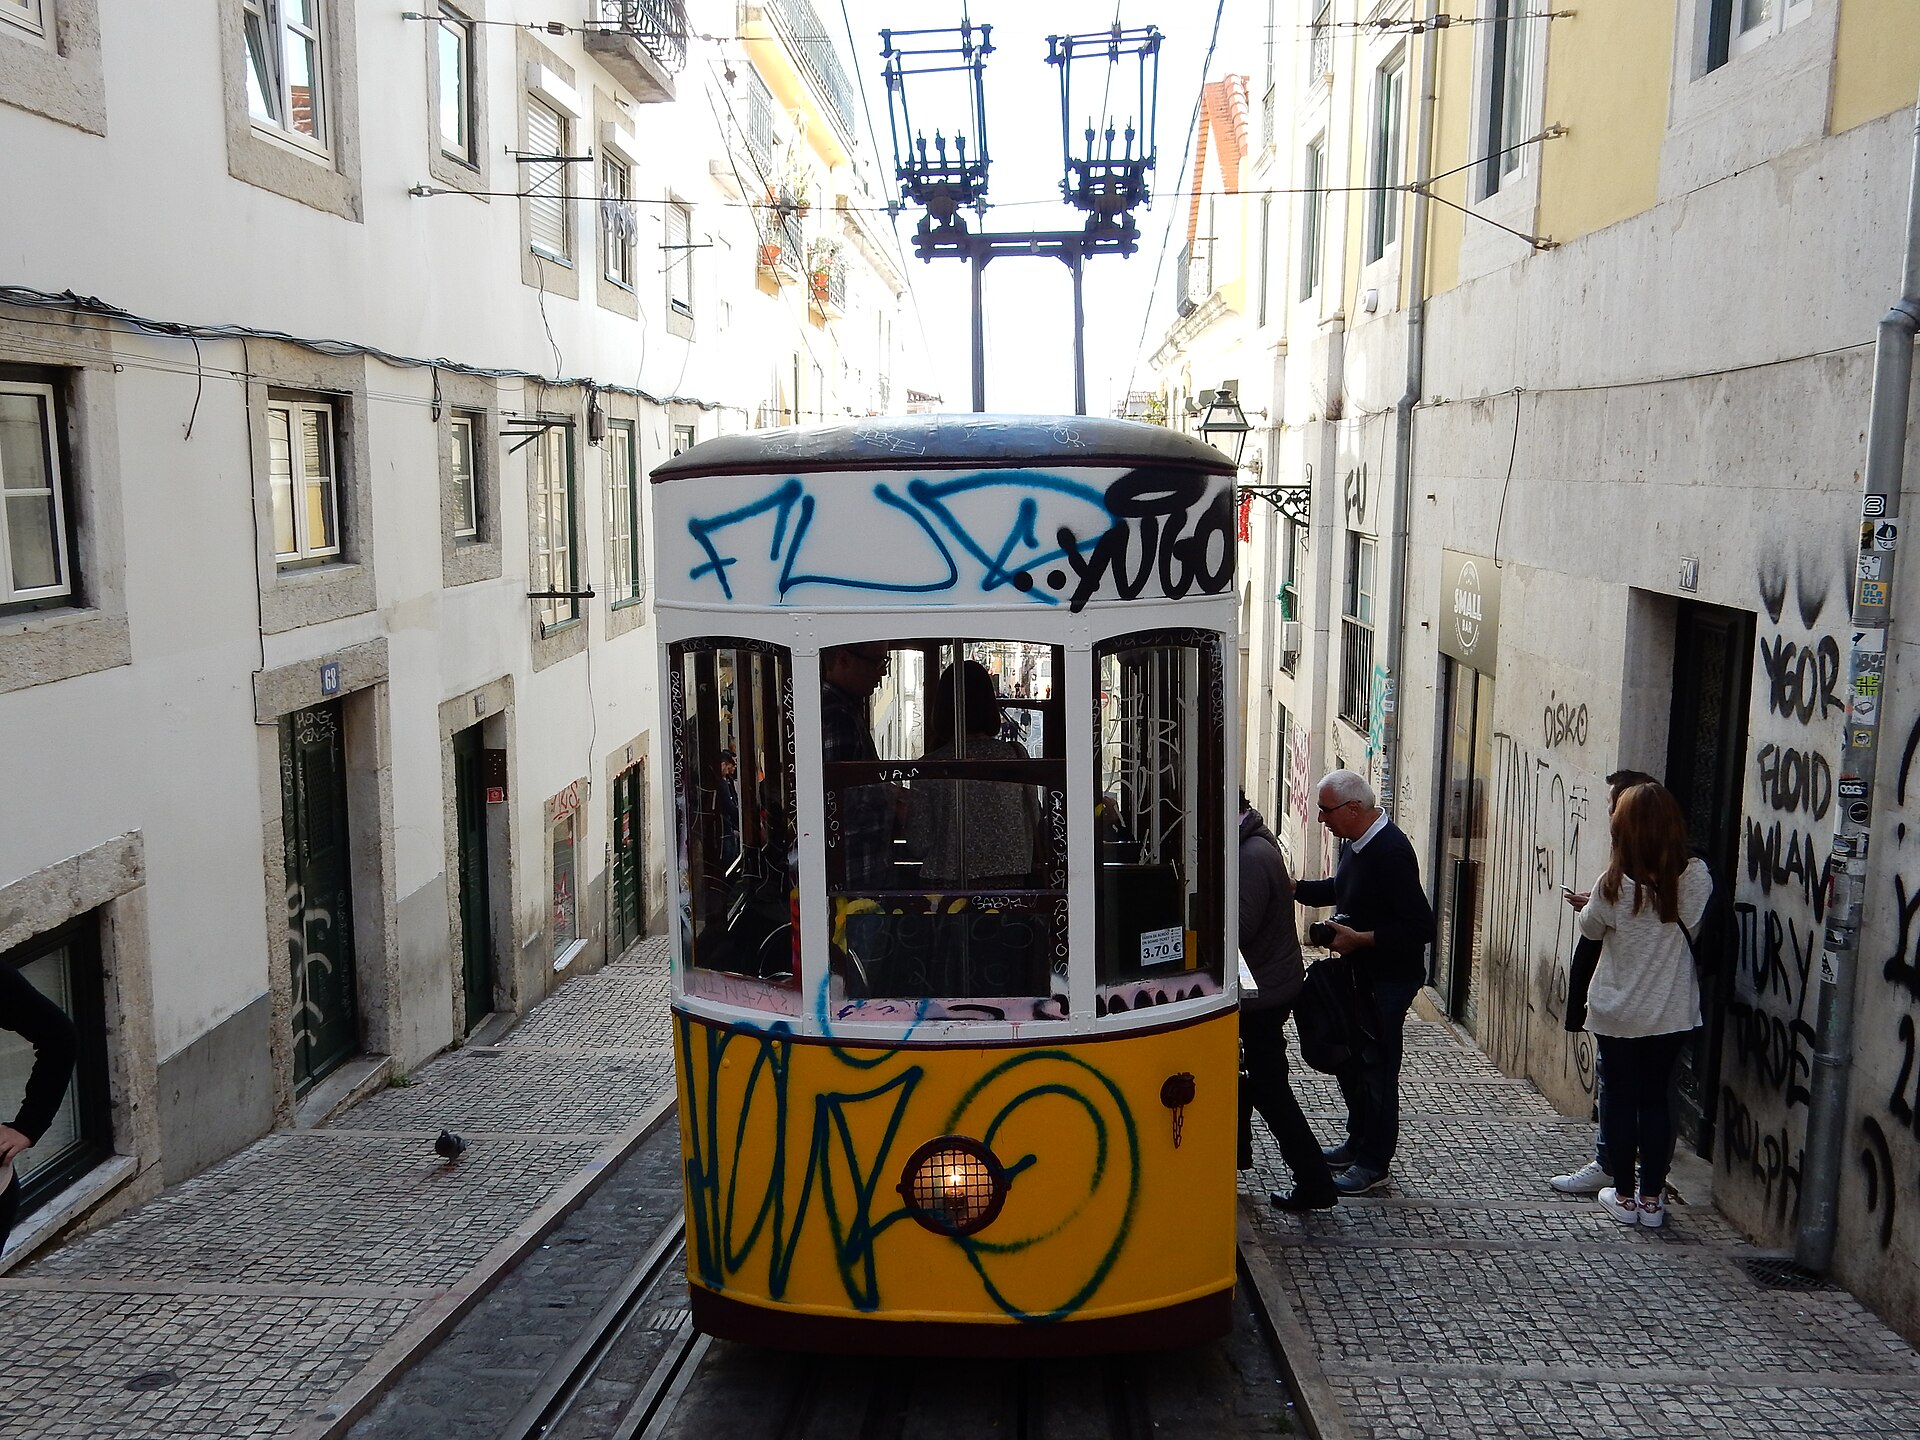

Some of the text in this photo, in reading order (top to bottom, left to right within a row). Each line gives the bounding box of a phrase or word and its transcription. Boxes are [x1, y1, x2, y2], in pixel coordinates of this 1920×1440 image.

[1682, 560, 1694, 587] 79
[1454, 588, 1482, 621] SMALL
[1462, 619, 1472, 634] BAR
[325, 667, 337, 690] 68
[1143, 944, 1170, 959] 3.70
[1173, 942, 1181, 953] €
